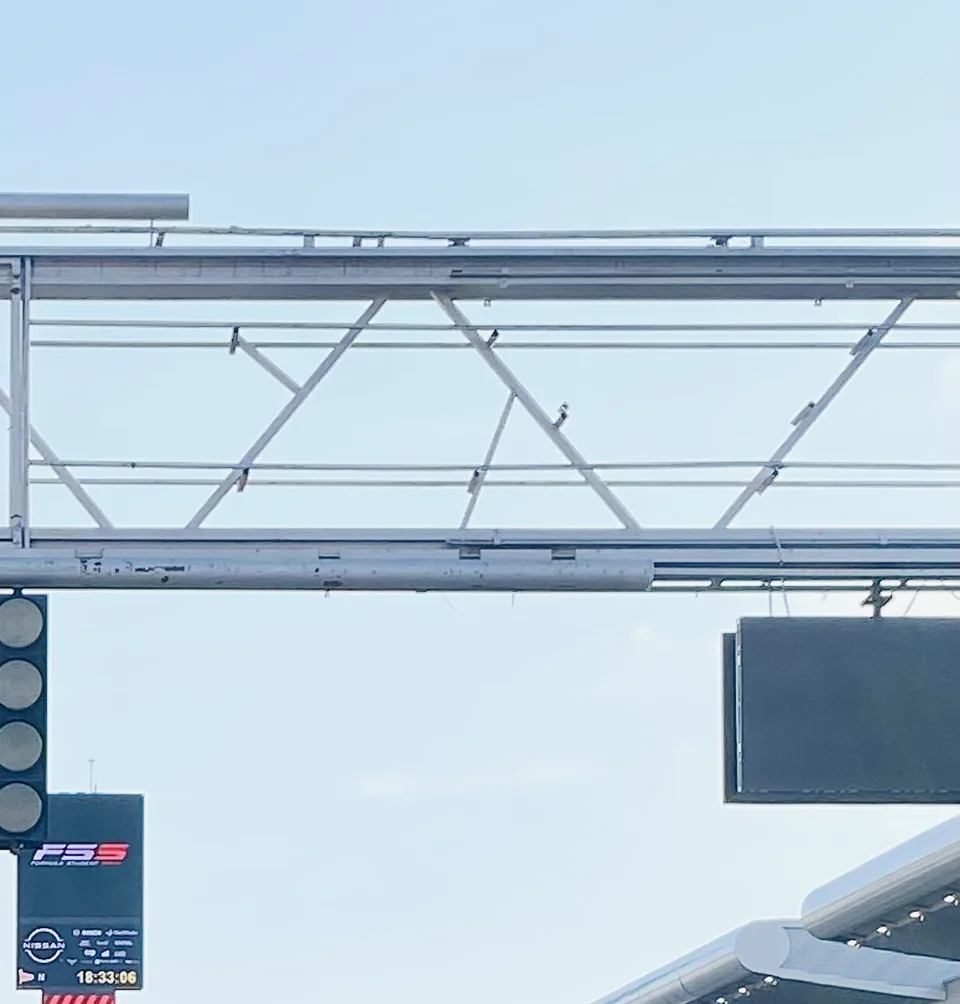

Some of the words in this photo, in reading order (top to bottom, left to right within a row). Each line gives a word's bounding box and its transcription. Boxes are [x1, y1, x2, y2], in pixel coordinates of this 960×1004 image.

[32, 843, 130, 861] FSS
[23, 942, 65, 950] NISSAN
[76, 970, 137, 984] 18:33:06
